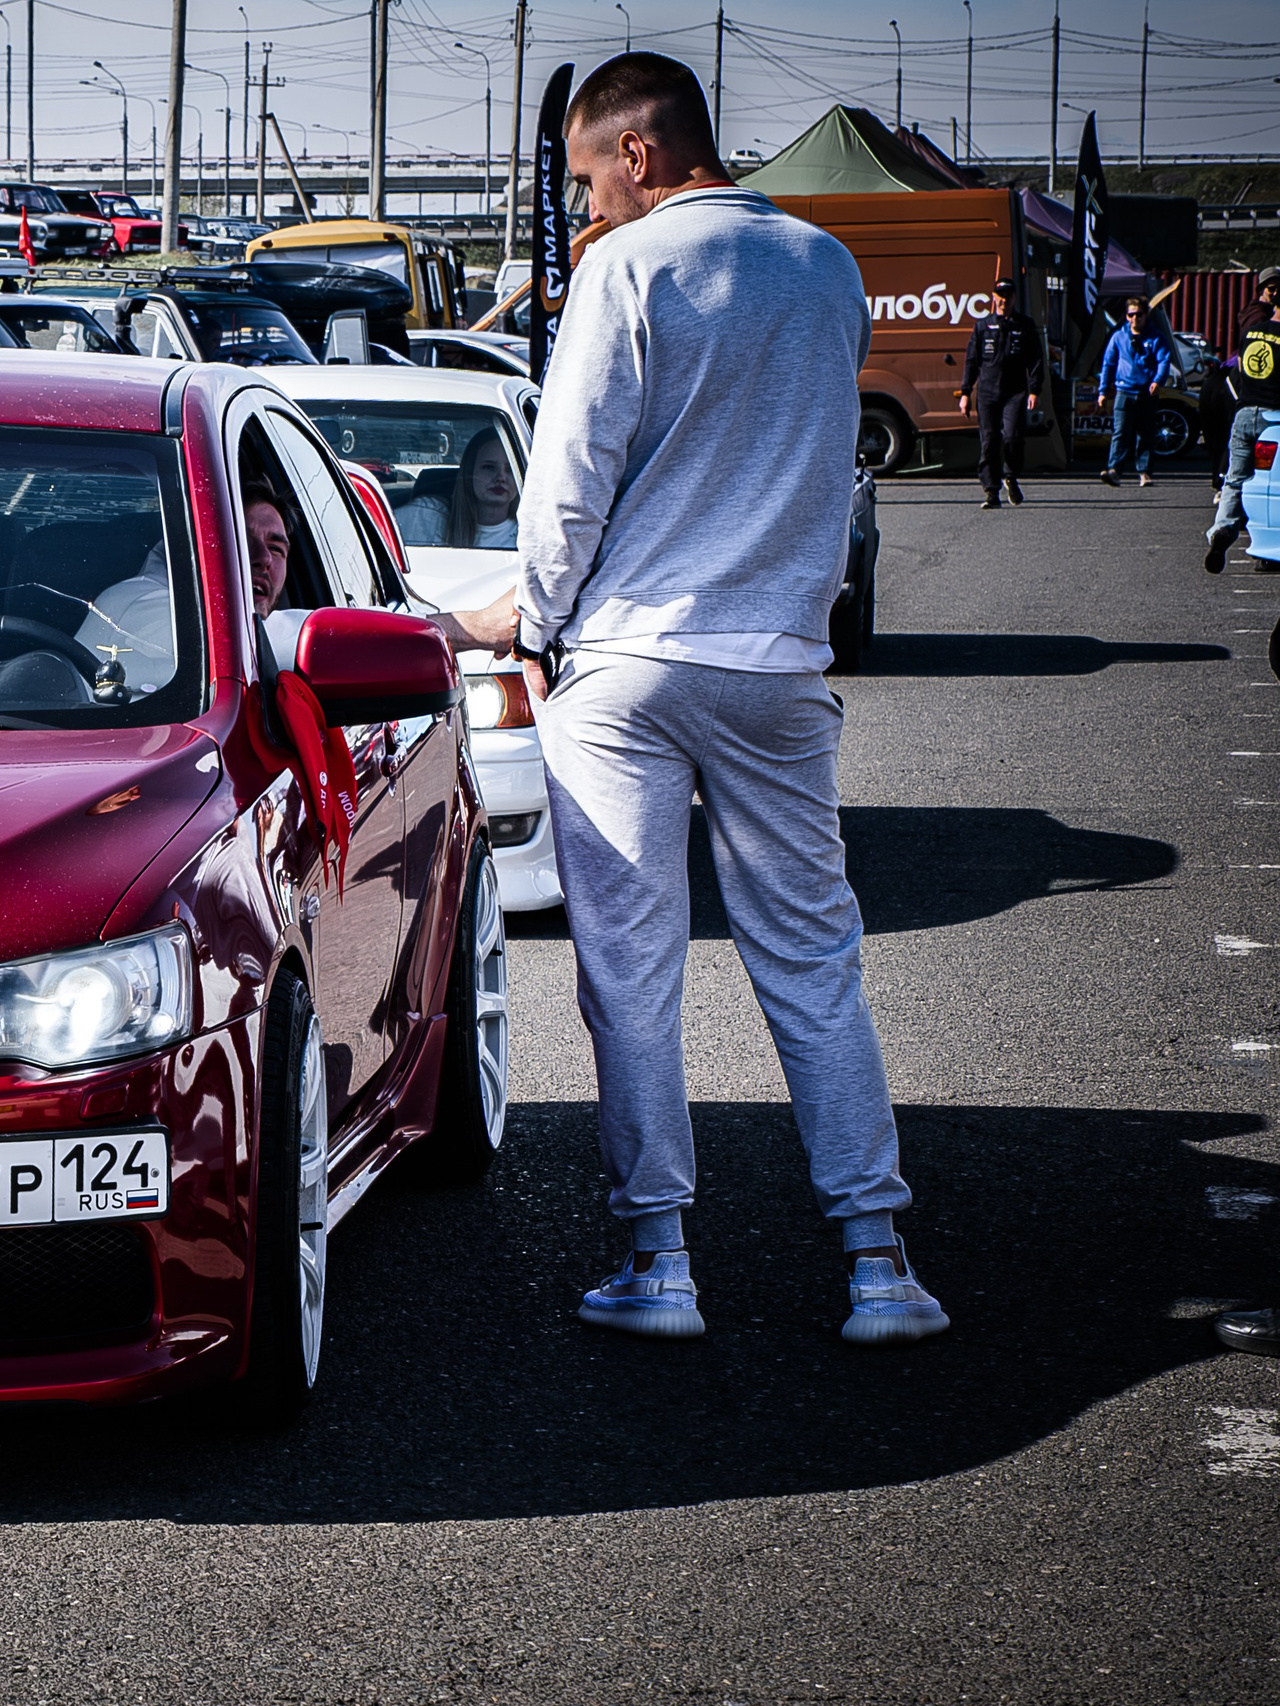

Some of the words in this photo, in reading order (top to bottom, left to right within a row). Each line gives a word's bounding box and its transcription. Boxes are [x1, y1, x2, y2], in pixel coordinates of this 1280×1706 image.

[541, 132, 557, 262] МАРКЕТ
[60, 1140, 150, 1192] 124
[80, 1192, 124, 1211] RUS
